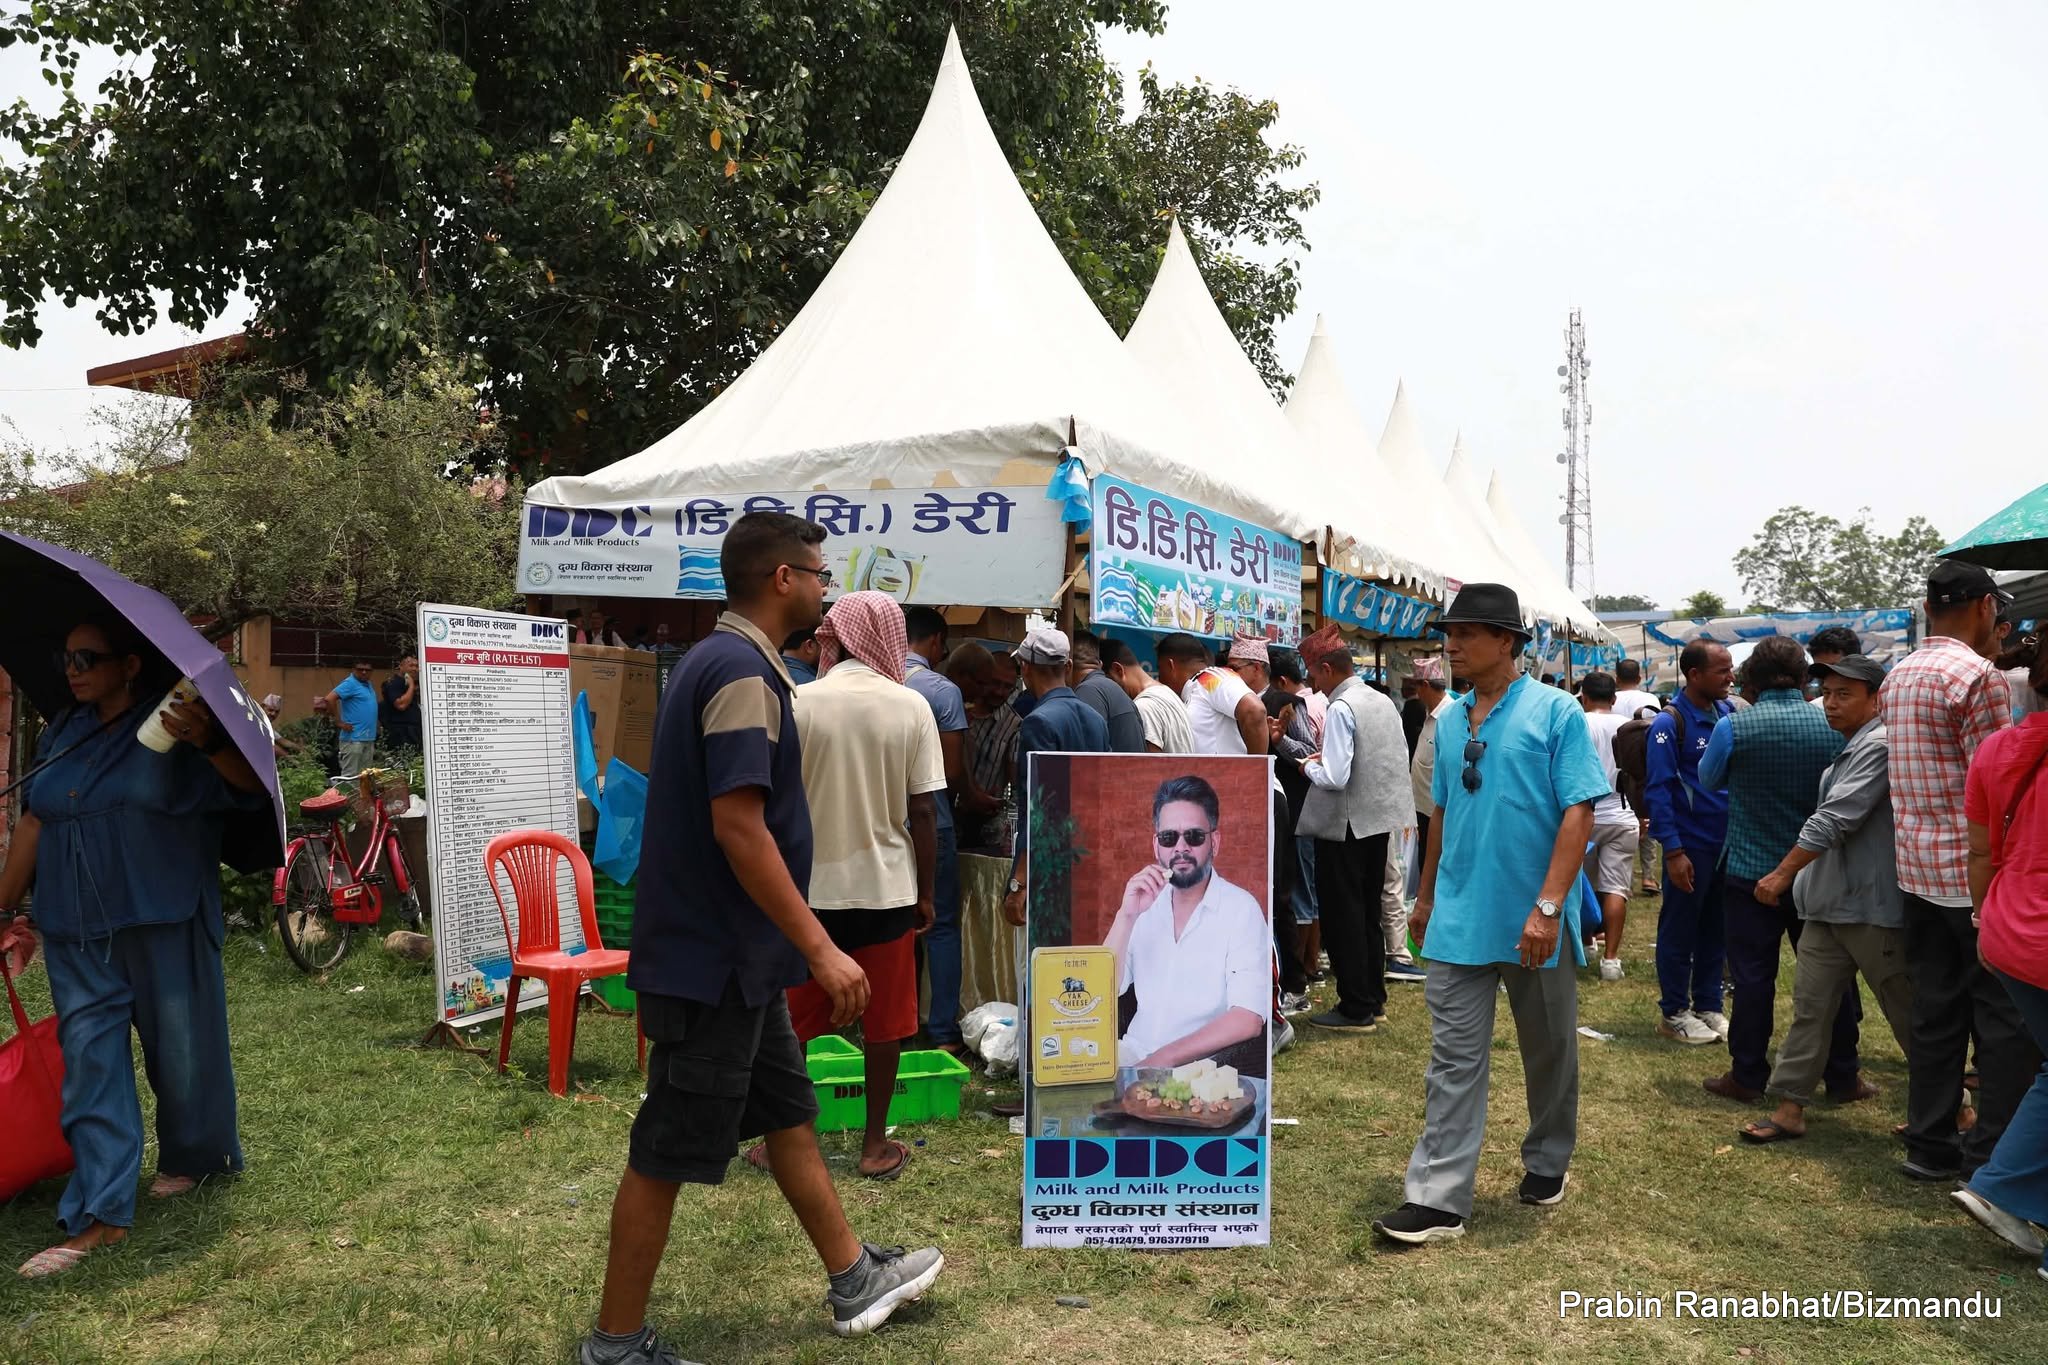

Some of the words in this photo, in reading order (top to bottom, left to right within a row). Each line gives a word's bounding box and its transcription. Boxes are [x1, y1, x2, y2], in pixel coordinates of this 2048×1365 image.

[528, 505, 653, 537] DDC
[913, 492, 1016, 535] डेरी
[553, 538, 571, 546] and
[574, 538, 594, 546] Milk
[597, 538, 640, 547] Products
[1230, 527, 1269, 584] डेरी
[558, 562, 577, 574] दुग्ध
[581, 561, 613, 573] विकास
[616, 561, 654, 573] संस्थान
[449, 617, 464, 628] दुग्ध
[467, 617, 490, 630] विकास
[493, 618, 517, 631] संस्थान
[531, 623, 563, 638] DDC
[492, 653, 541, 666] (RATE-LIST)
[834, 1084, 867, 1099] DD
[1034, 1138, 1259, 1178] DDC
[1035, 1183, 1078, 1195] Milk
[1085, 1183, 1120, 1195] and
[1127, 1182, 1169, 1195] Milk
[1177, 1182, 1260, 1195] Products
[1031, 1203, 1081, 1221] दुग्ध
[1089, 1200, 1167, 1217] विकास
[1175, 1200, 1260, 1216] संस्थान
[1035, 1224, 1068, 1235] नेपाल
[1074, 1224, 1133, 1235] सरकारको
[1167, 1223, 1217, 1234] स्वामित्व
[1222, 1222, 1259, 1234] भएको
